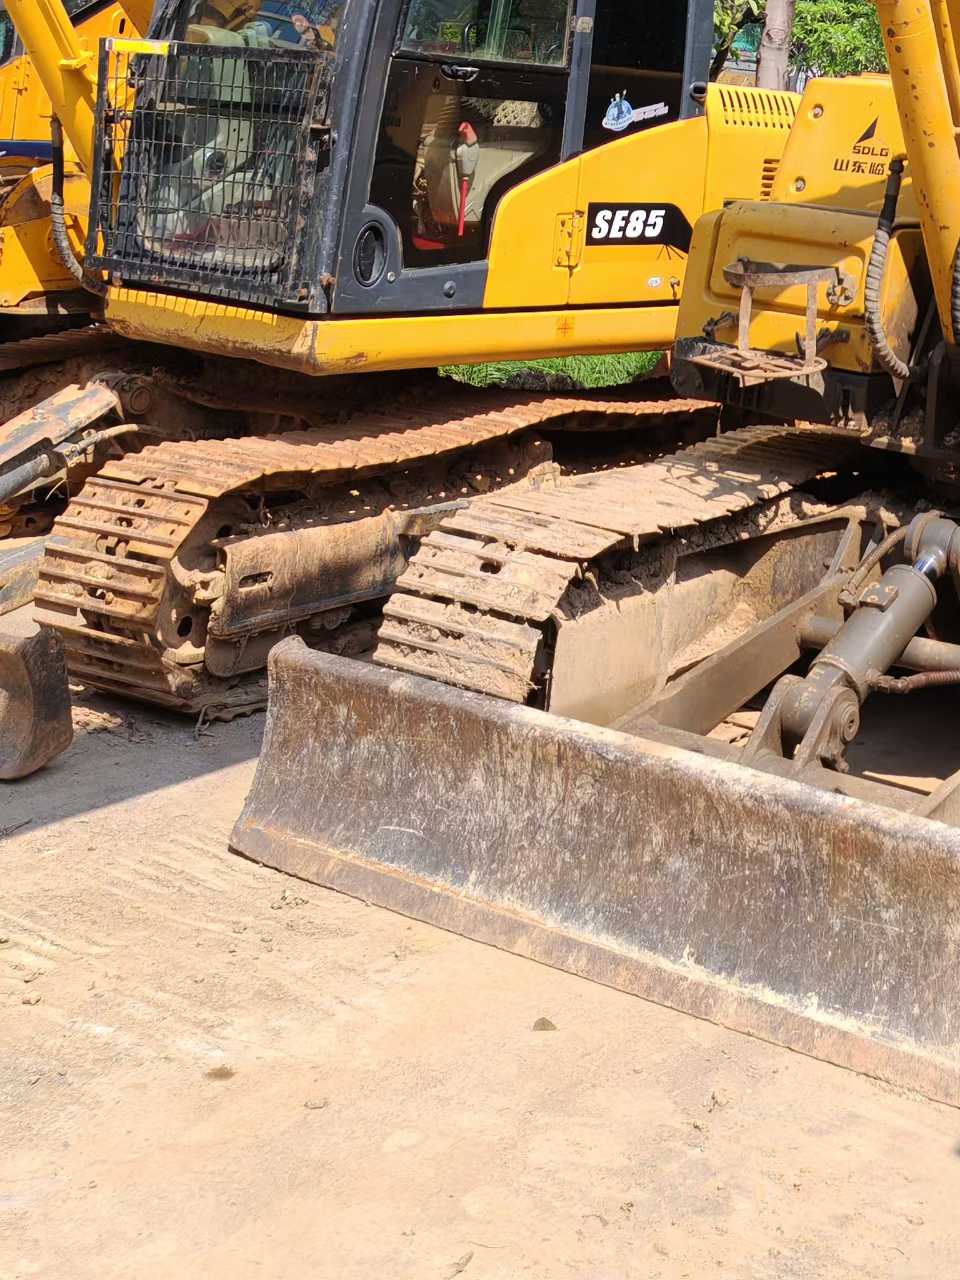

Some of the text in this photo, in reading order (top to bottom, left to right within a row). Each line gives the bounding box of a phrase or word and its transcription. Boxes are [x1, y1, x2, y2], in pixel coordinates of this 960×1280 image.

[852, 145, 890, 157] SDLG
[833, 158, 889, 176] 山东临
[591, 209, 666, 239] SE85
